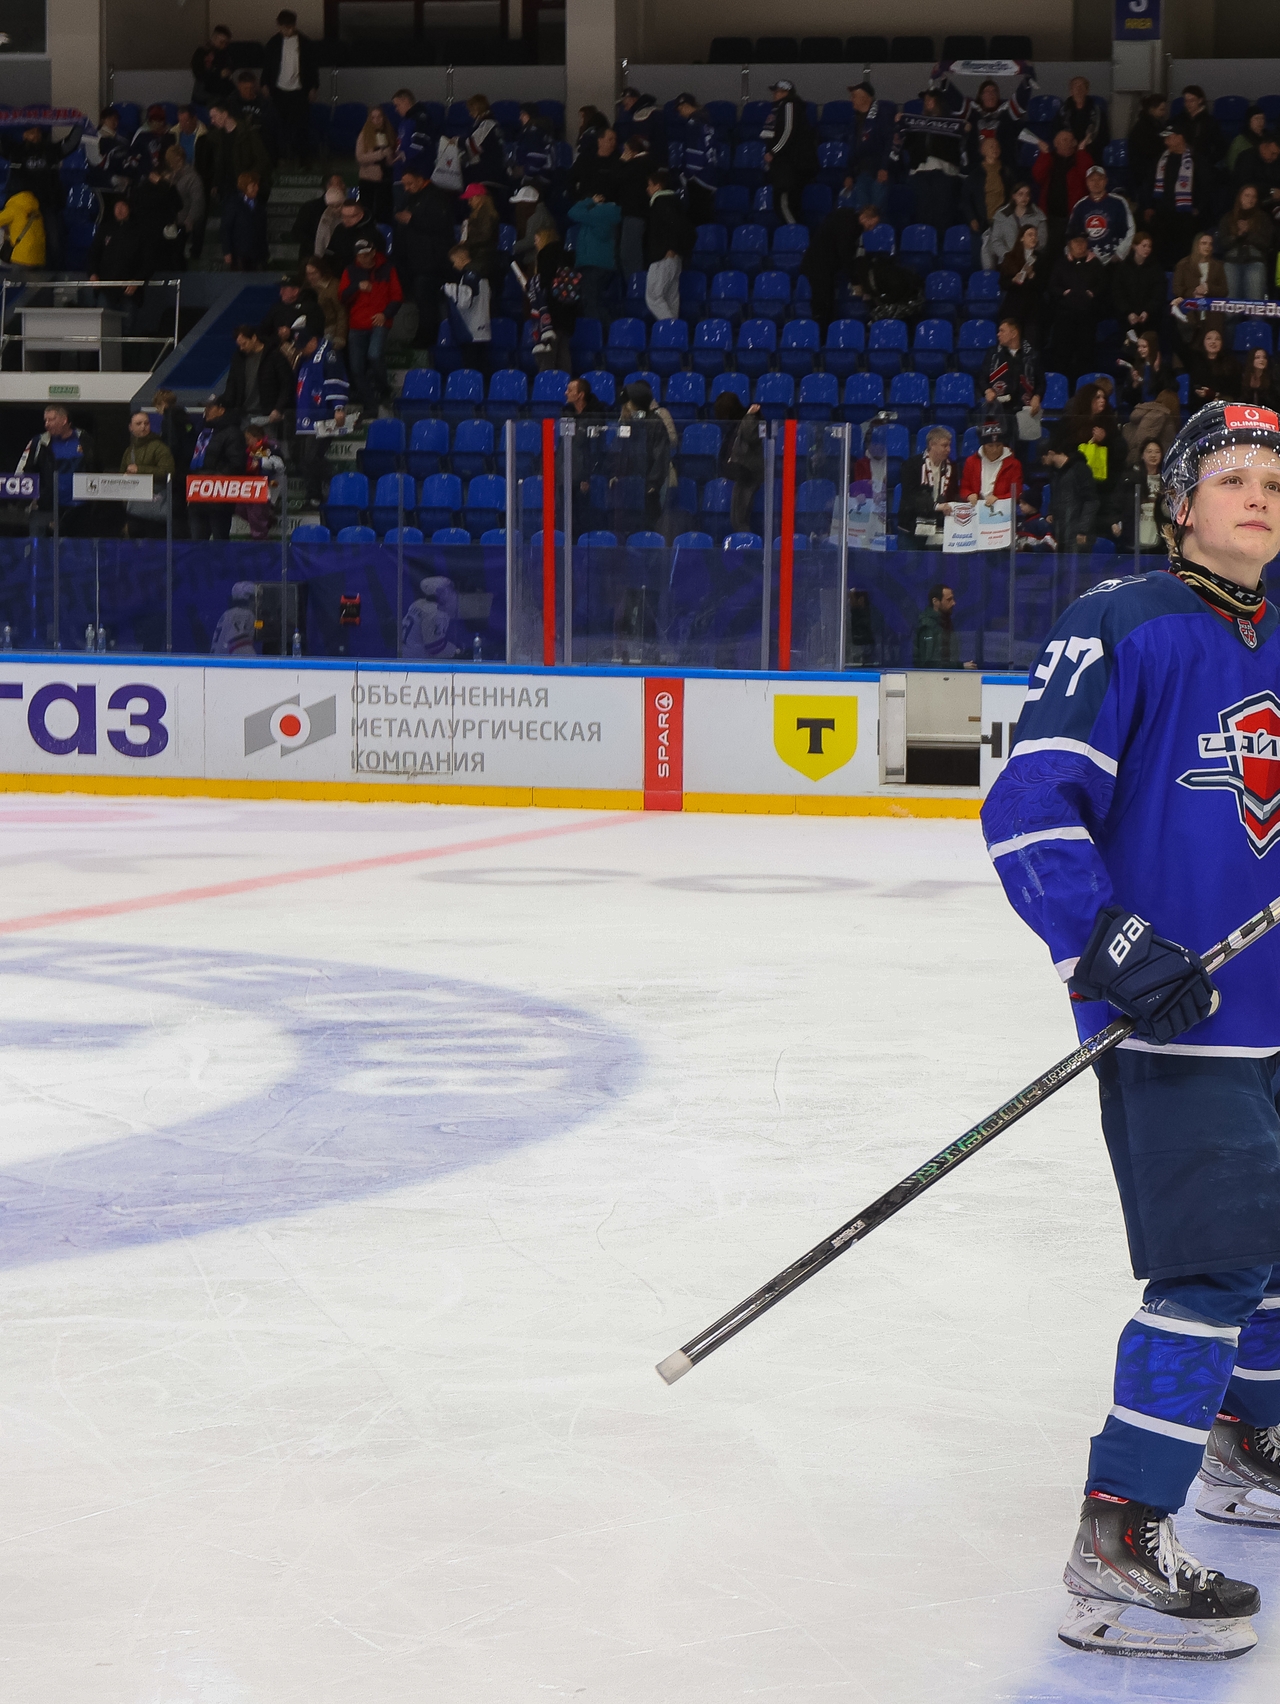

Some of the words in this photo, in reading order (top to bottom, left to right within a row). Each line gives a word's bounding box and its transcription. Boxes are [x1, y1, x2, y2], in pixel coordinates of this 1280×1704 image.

[1229, 421, 1276, 430] OLIMPBET
[188, 480, 266, 498] FONBET
[350, 683, 549, 709] ОБЪЕДИНЕННАЯ
[350, 716, 602, 743] МЕТАЛЛУРГИЧЕСКАЯ
[657, 712, 671, 778] SPAR
[350, 749, 486, 774] КОМПАНИЯ
